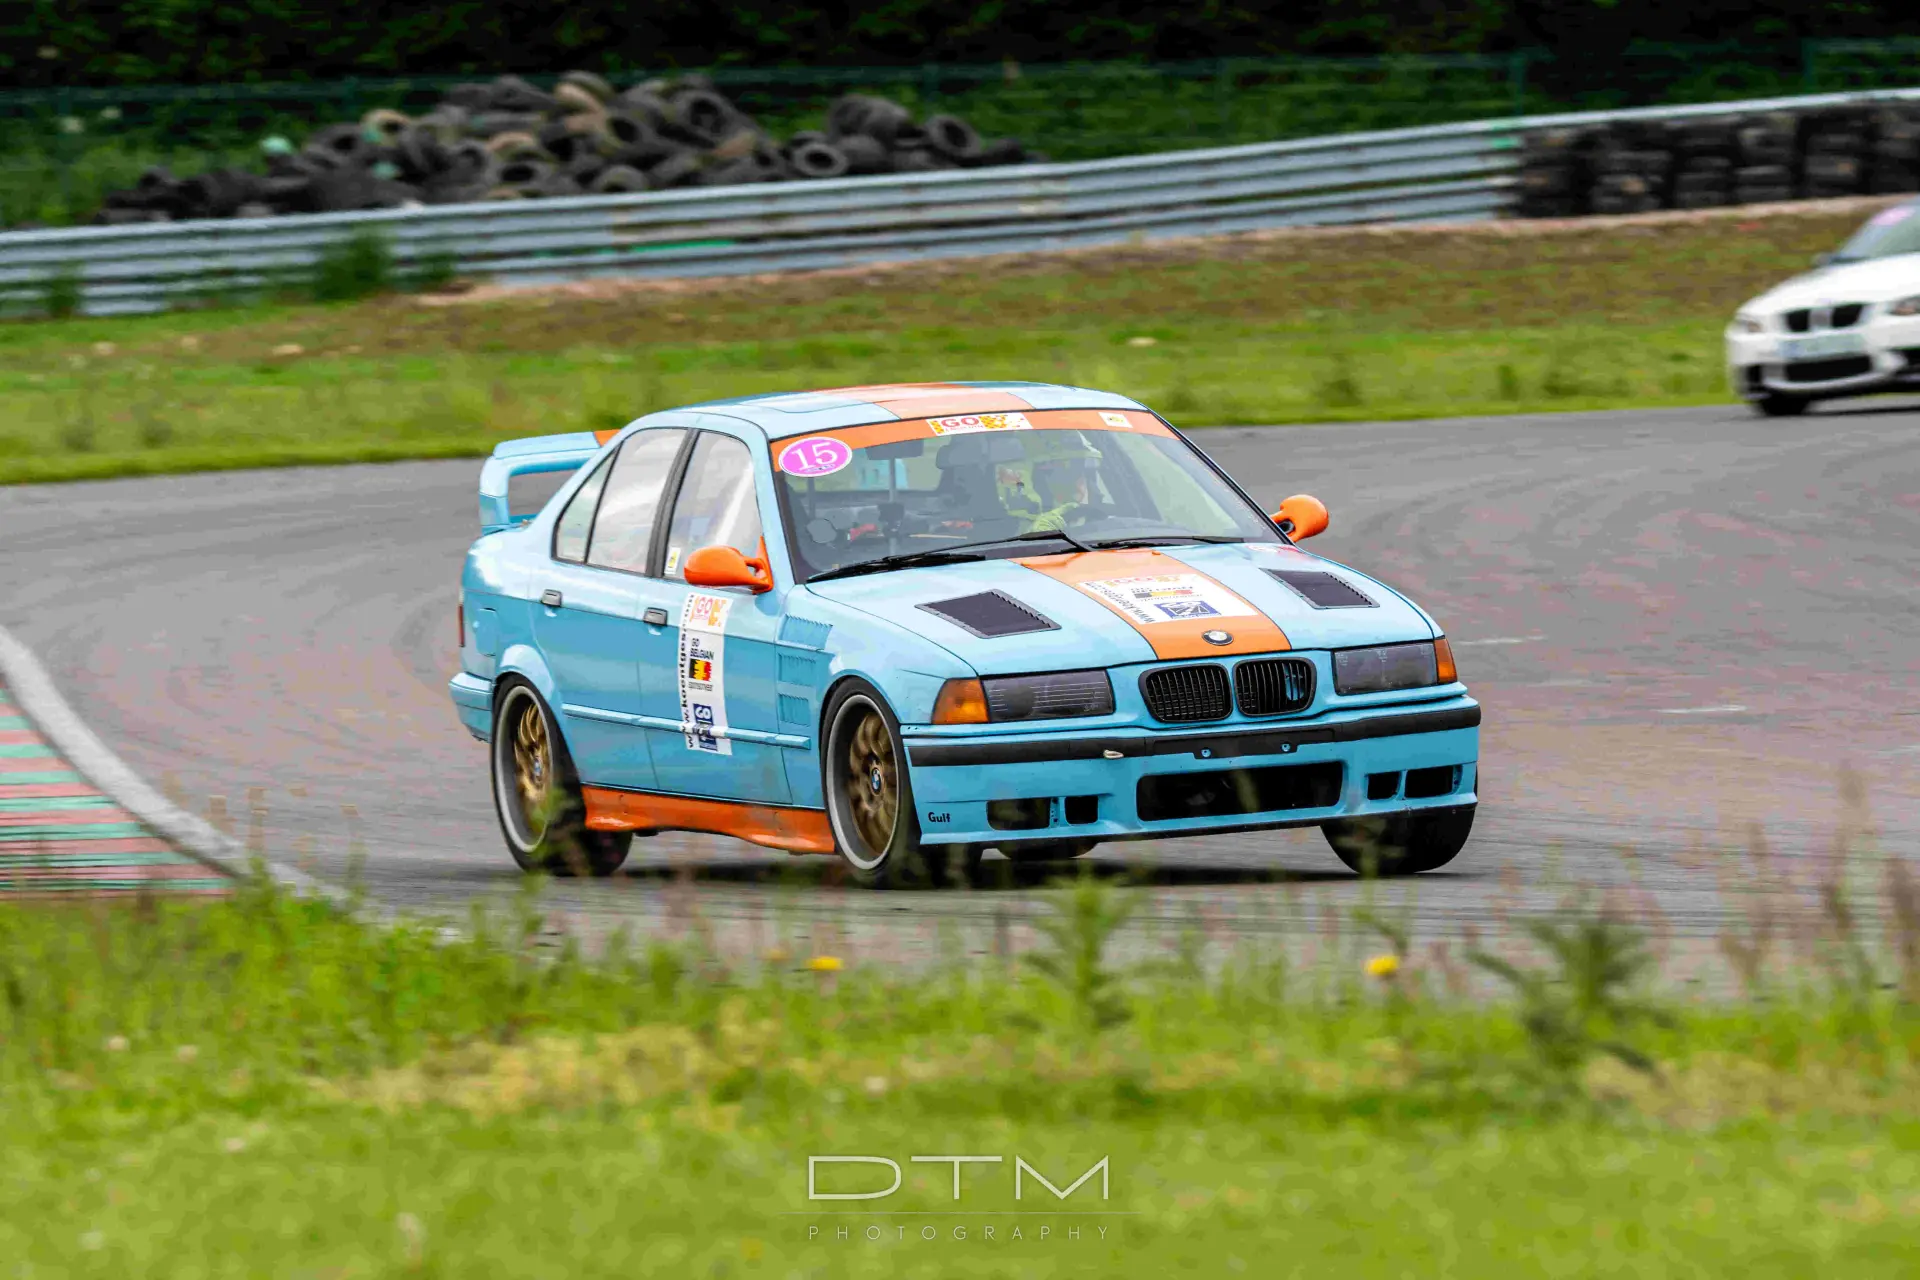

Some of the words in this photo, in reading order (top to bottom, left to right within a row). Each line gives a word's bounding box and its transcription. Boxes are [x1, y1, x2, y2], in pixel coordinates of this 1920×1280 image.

[941, 416, 980, 428] GO
[790, 441, 838, 471] 15
[928, 811, 951, 823] Gulf
